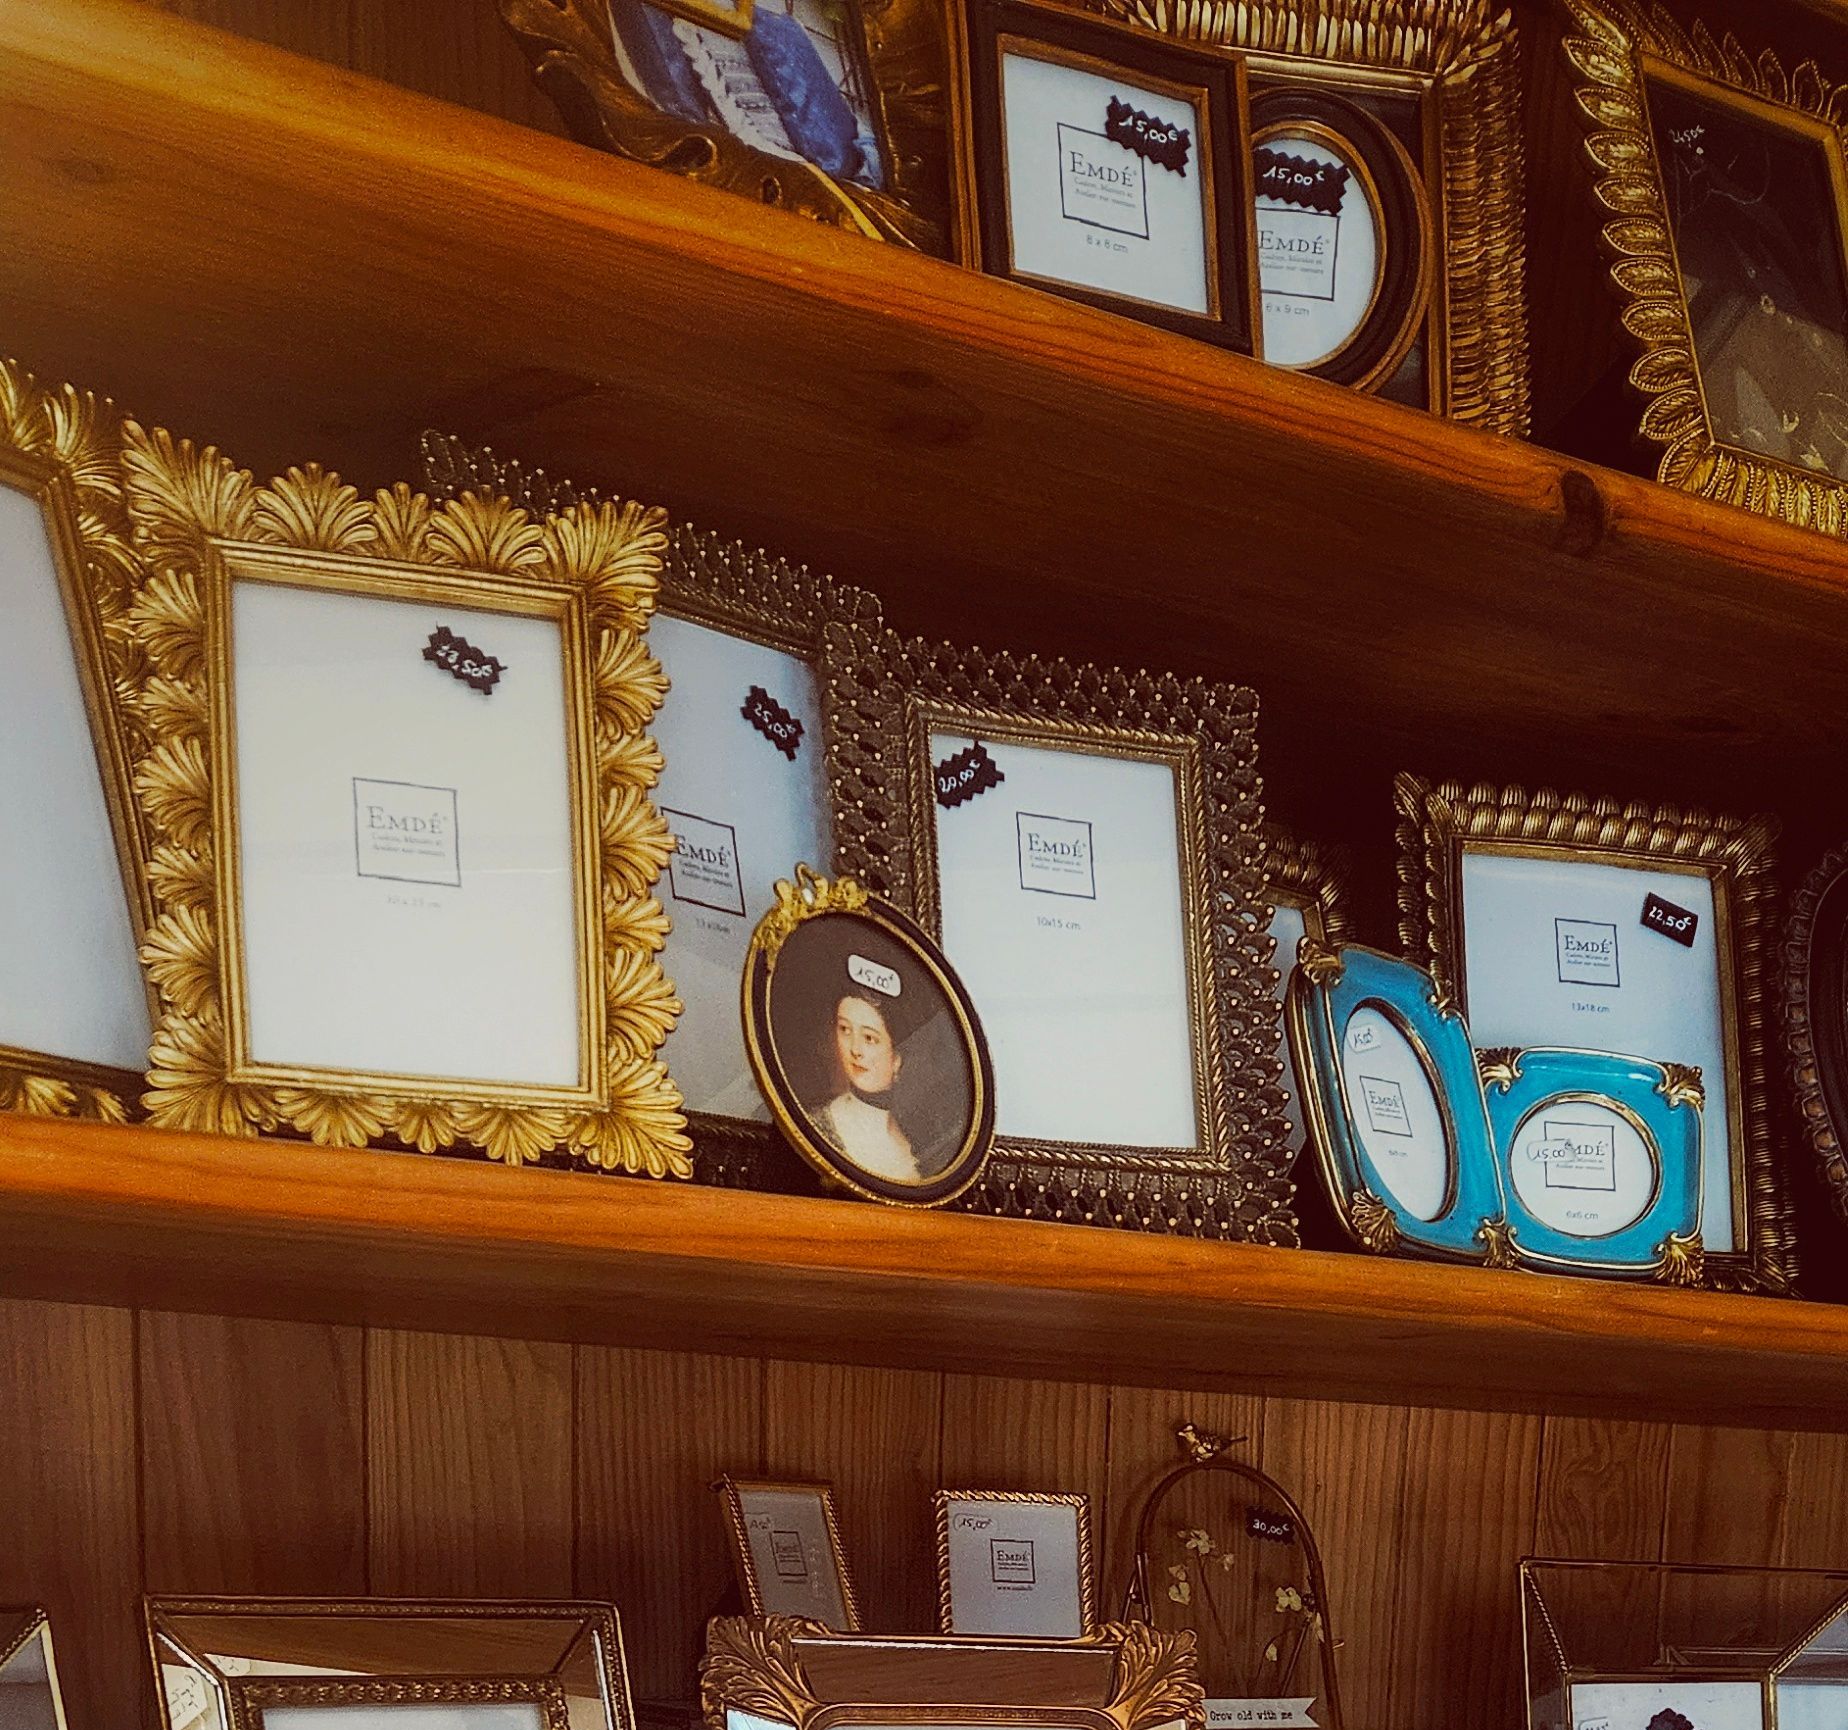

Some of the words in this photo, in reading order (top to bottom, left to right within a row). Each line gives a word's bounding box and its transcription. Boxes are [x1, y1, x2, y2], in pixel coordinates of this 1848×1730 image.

[1118, 115, 1179, 144] 15,00€
[1262, 165, 1326, 186] 15,00€
[1649, 905, 1692, 931] 22,50€
[1236, 1710, 1253, 1721] old
[1256, 1709, 1278, 1721] with
[1280, 1711, 1294, 1720] me
